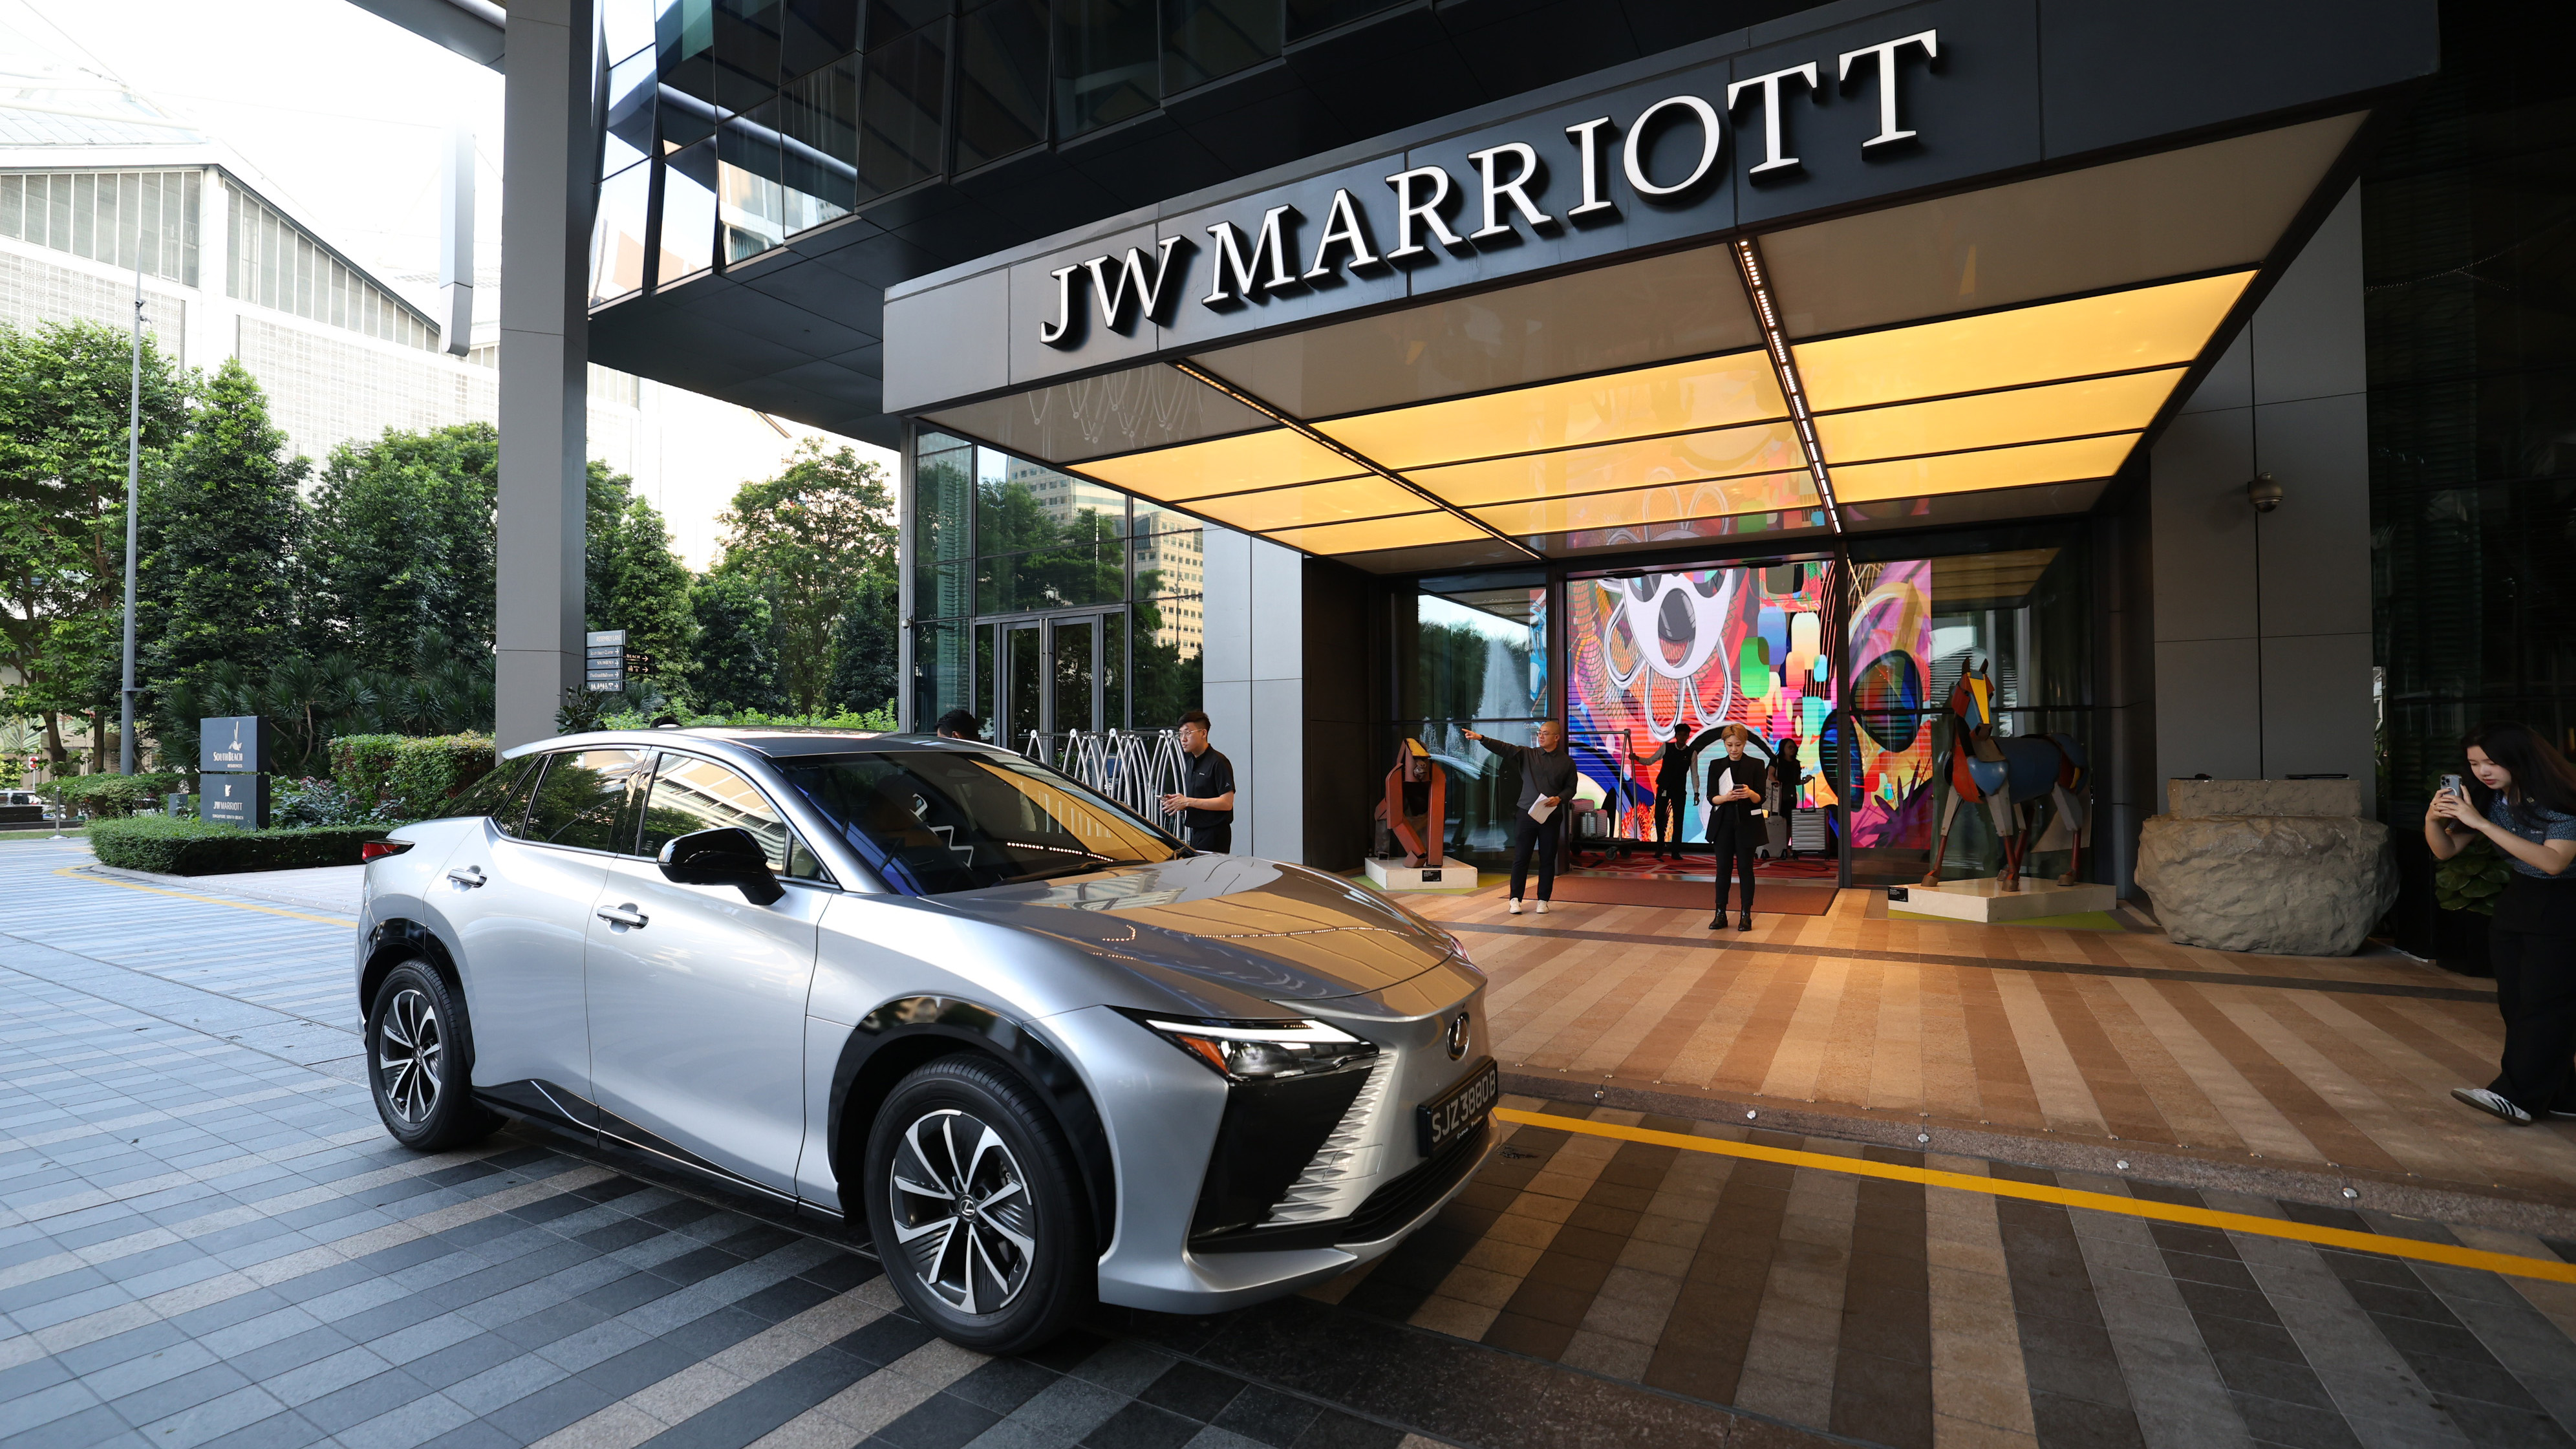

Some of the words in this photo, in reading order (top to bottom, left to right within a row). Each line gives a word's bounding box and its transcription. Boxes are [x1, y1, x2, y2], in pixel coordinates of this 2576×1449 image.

[1040, 235, 1183, 346] JW
[1203, 29, 1937, 307] MARRIOTT
[220, 802, 242, 811] MARRIOTT
